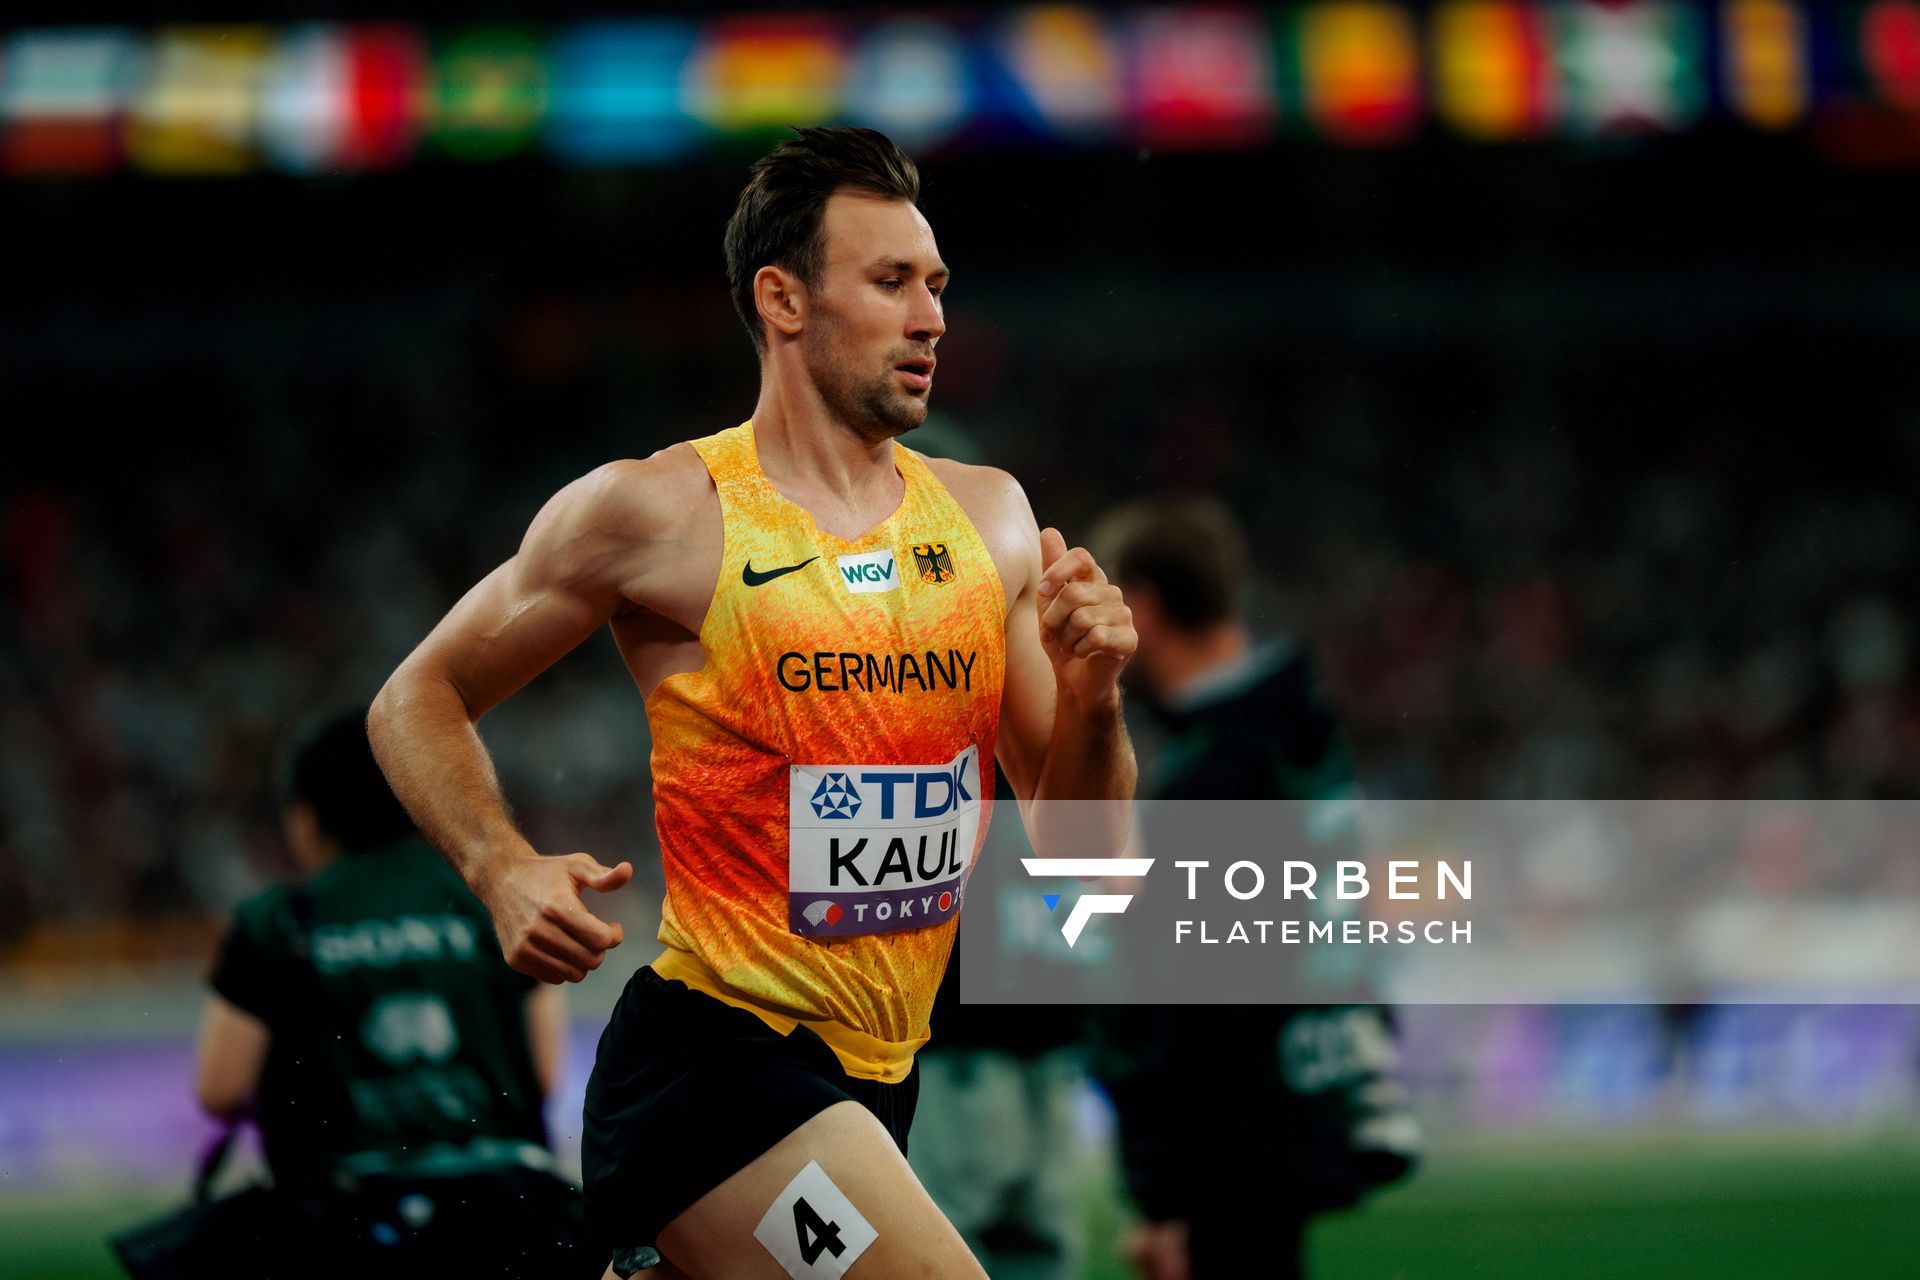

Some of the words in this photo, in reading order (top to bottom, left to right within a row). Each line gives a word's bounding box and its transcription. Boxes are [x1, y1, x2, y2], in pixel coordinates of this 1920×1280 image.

[841, 558, 894, 583] WGV
[776, 649, 976, 693] GERMANY
[861, 756, 972, 820] TDK
[829, 828, 962, 886] KAUL
[853, 891, 952, 922] TOKYO
[793, 1196, 847, 1266] 4
